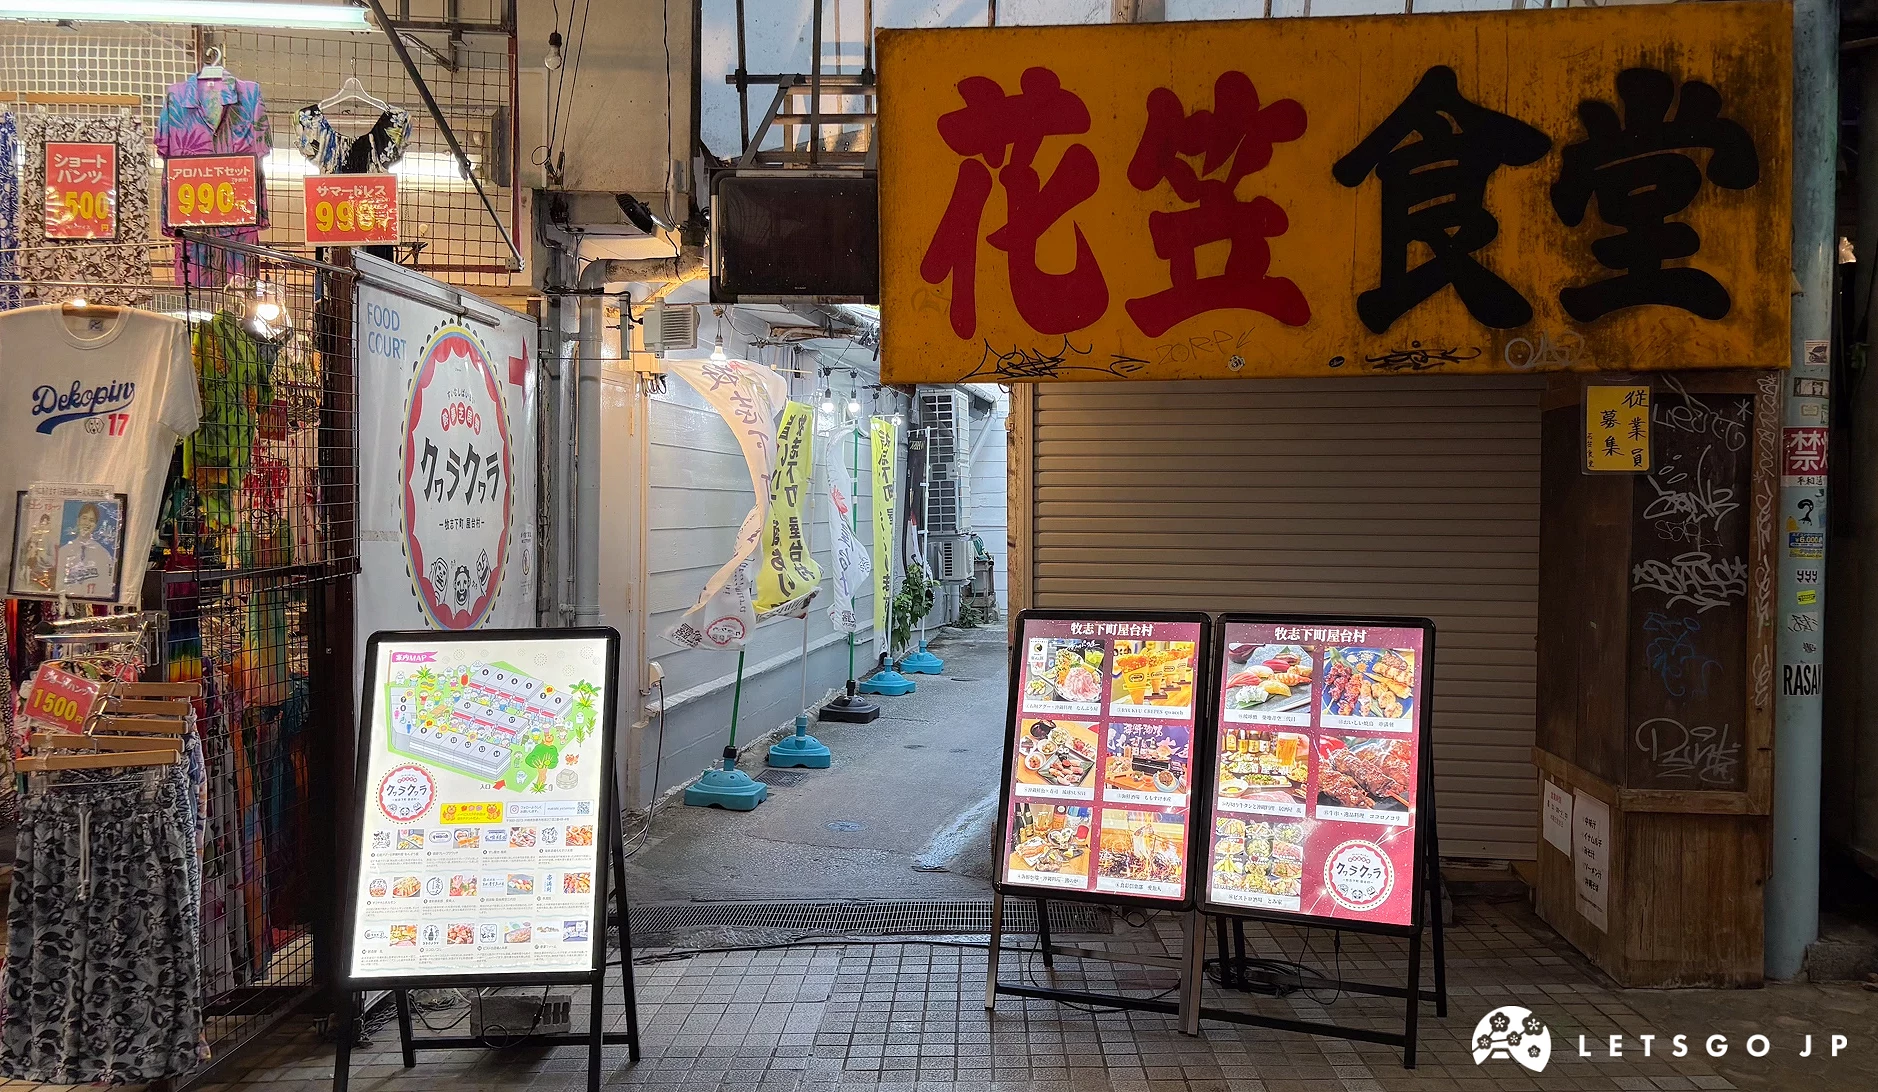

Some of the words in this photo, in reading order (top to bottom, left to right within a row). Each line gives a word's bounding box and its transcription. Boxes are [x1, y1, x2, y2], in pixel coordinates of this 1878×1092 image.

[54, 153, 107, 168] ショート
[173, 166, 251, 178] アロハ上下セット
[57, 169, 102, 184] パンツ
[316, 184, 387, 197] サマードレス
[920, 65, 1759, 339] 花笠食堂
[366, 302, 400, 332] FOOD
[368, 331, 406, 361] COURT
[32, 380, 135, 415] Dekopin
[108, 413, 130, 436] 17
[1599, 409, 1625, 457] 募集
[1621, 390, 1649, 467] 従業員
[1071, 622, 1154, 637] 牧志下町屋台村
[1274, 627, 1367, 643] 牧志下町屋台村
